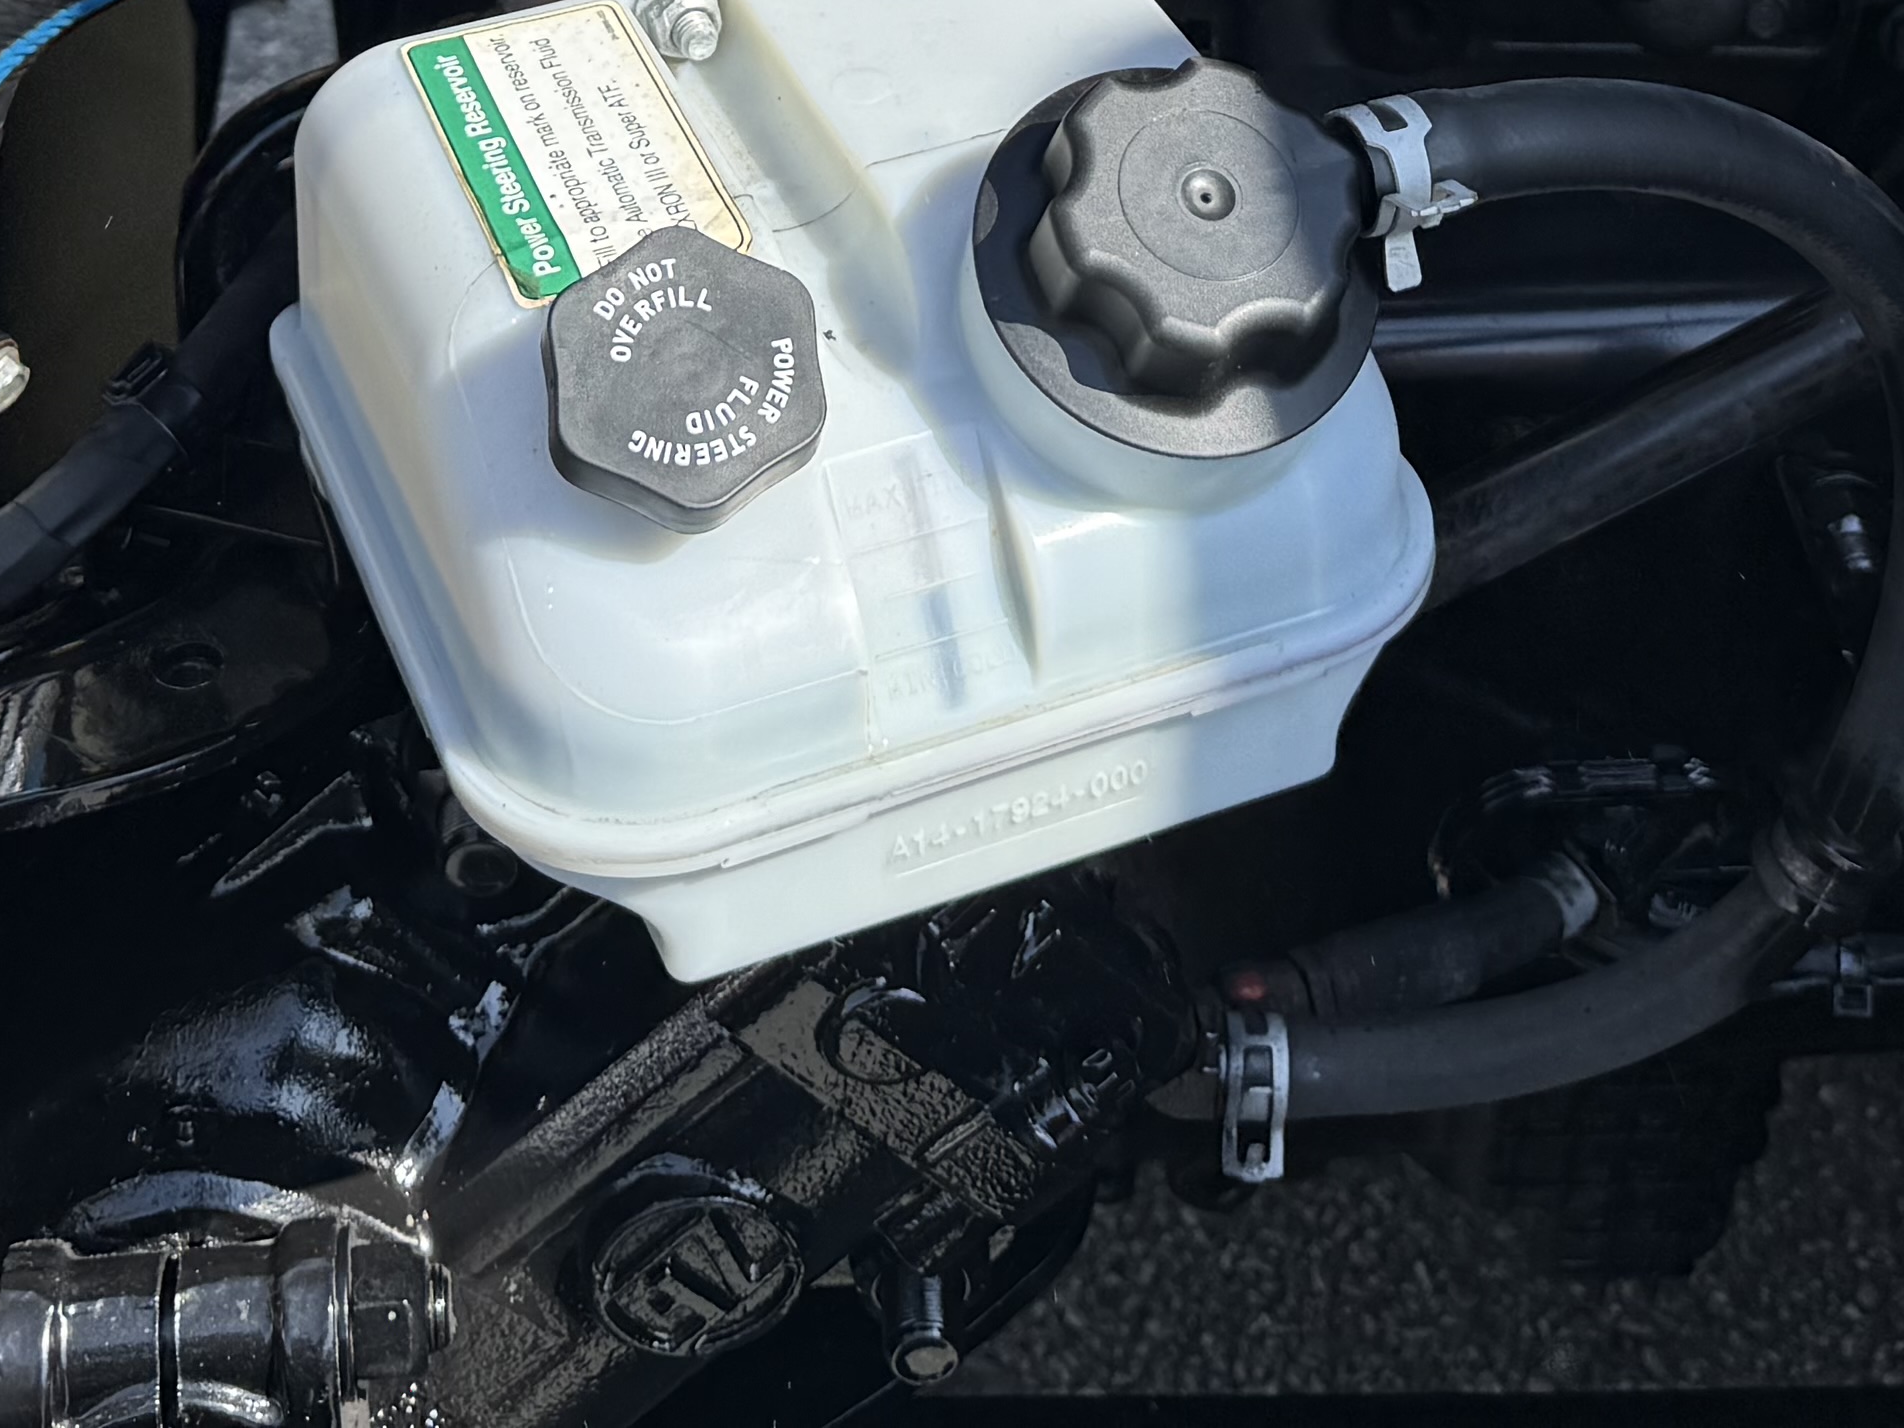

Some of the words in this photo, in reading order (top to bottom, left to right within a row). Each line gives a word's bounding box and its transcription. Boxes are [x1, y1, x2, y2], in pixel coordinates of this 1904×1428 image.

[486, 32, 532, 93] reservoir.
[529, 36, 565, 71] Fluid
[433, 54, 494, 139] Reservoir
[519, 93, 540, 112] on
[558, 70, 609, 157] Transmission
[600, 78, 630, 110] ATF.
[525, 112, 557, 148] mark
[617, 110, 651, 149] Super
[640, 150, 658, 166] or
[477, 137, 531, 215] Steering
[547, 149, 603, 223] appropriate
[597, 157, 648, 224] Automatic
[519, 218, 563, 278] Power
[590, 225, 609, 243] to
[592, 288, 626, 321] DO
[629, 256, 679, 293] NOT
[610, 284, 713, 364] OVERFILL
[685, 374, 760, 435] FLUID
[756, 336, 796, 425] POWER
[627, 428, 757, 468] STEERING
